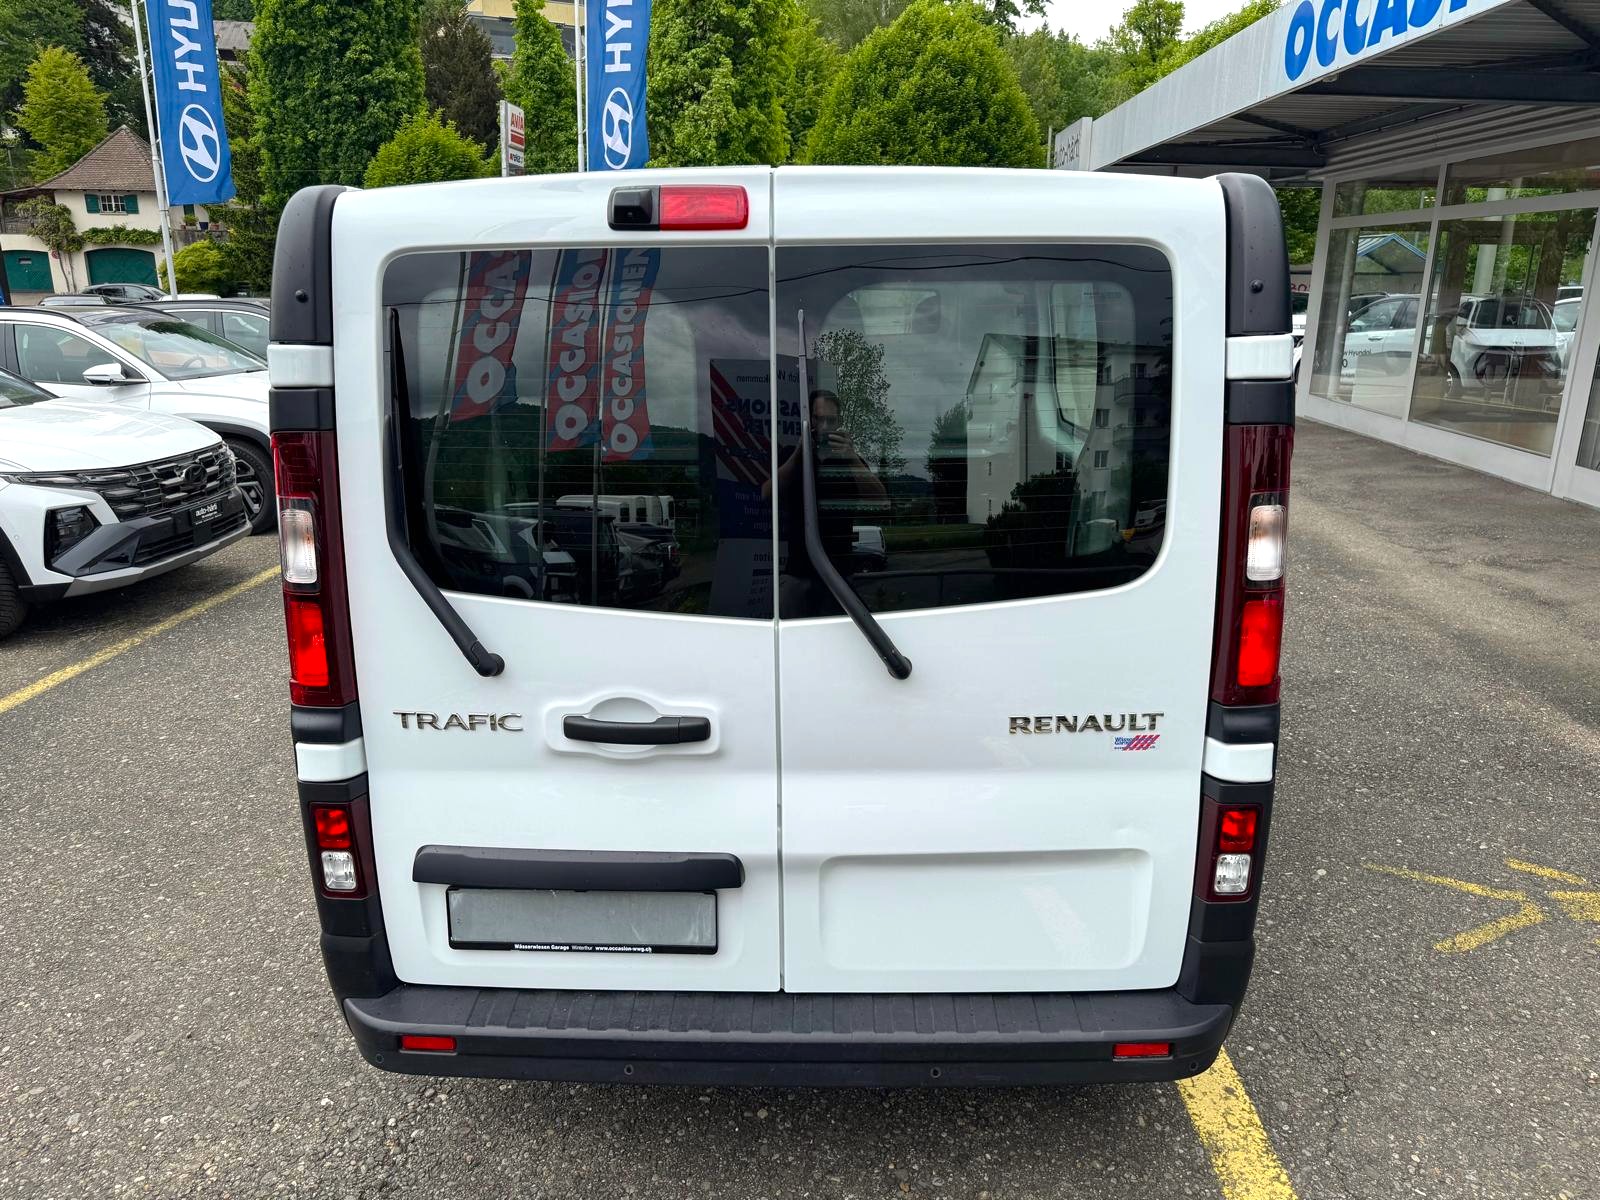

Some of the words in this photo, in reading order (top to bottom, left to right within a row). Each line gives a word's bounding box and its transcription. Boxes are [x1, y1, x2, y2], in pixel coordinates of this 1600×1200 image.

[604, 0, 633, 73] HY
[466, 249, 521, 404] OCCA
[392, 711, 524, 732] TRAFIC
[1008, 712, 1165, 734] RENAULT
